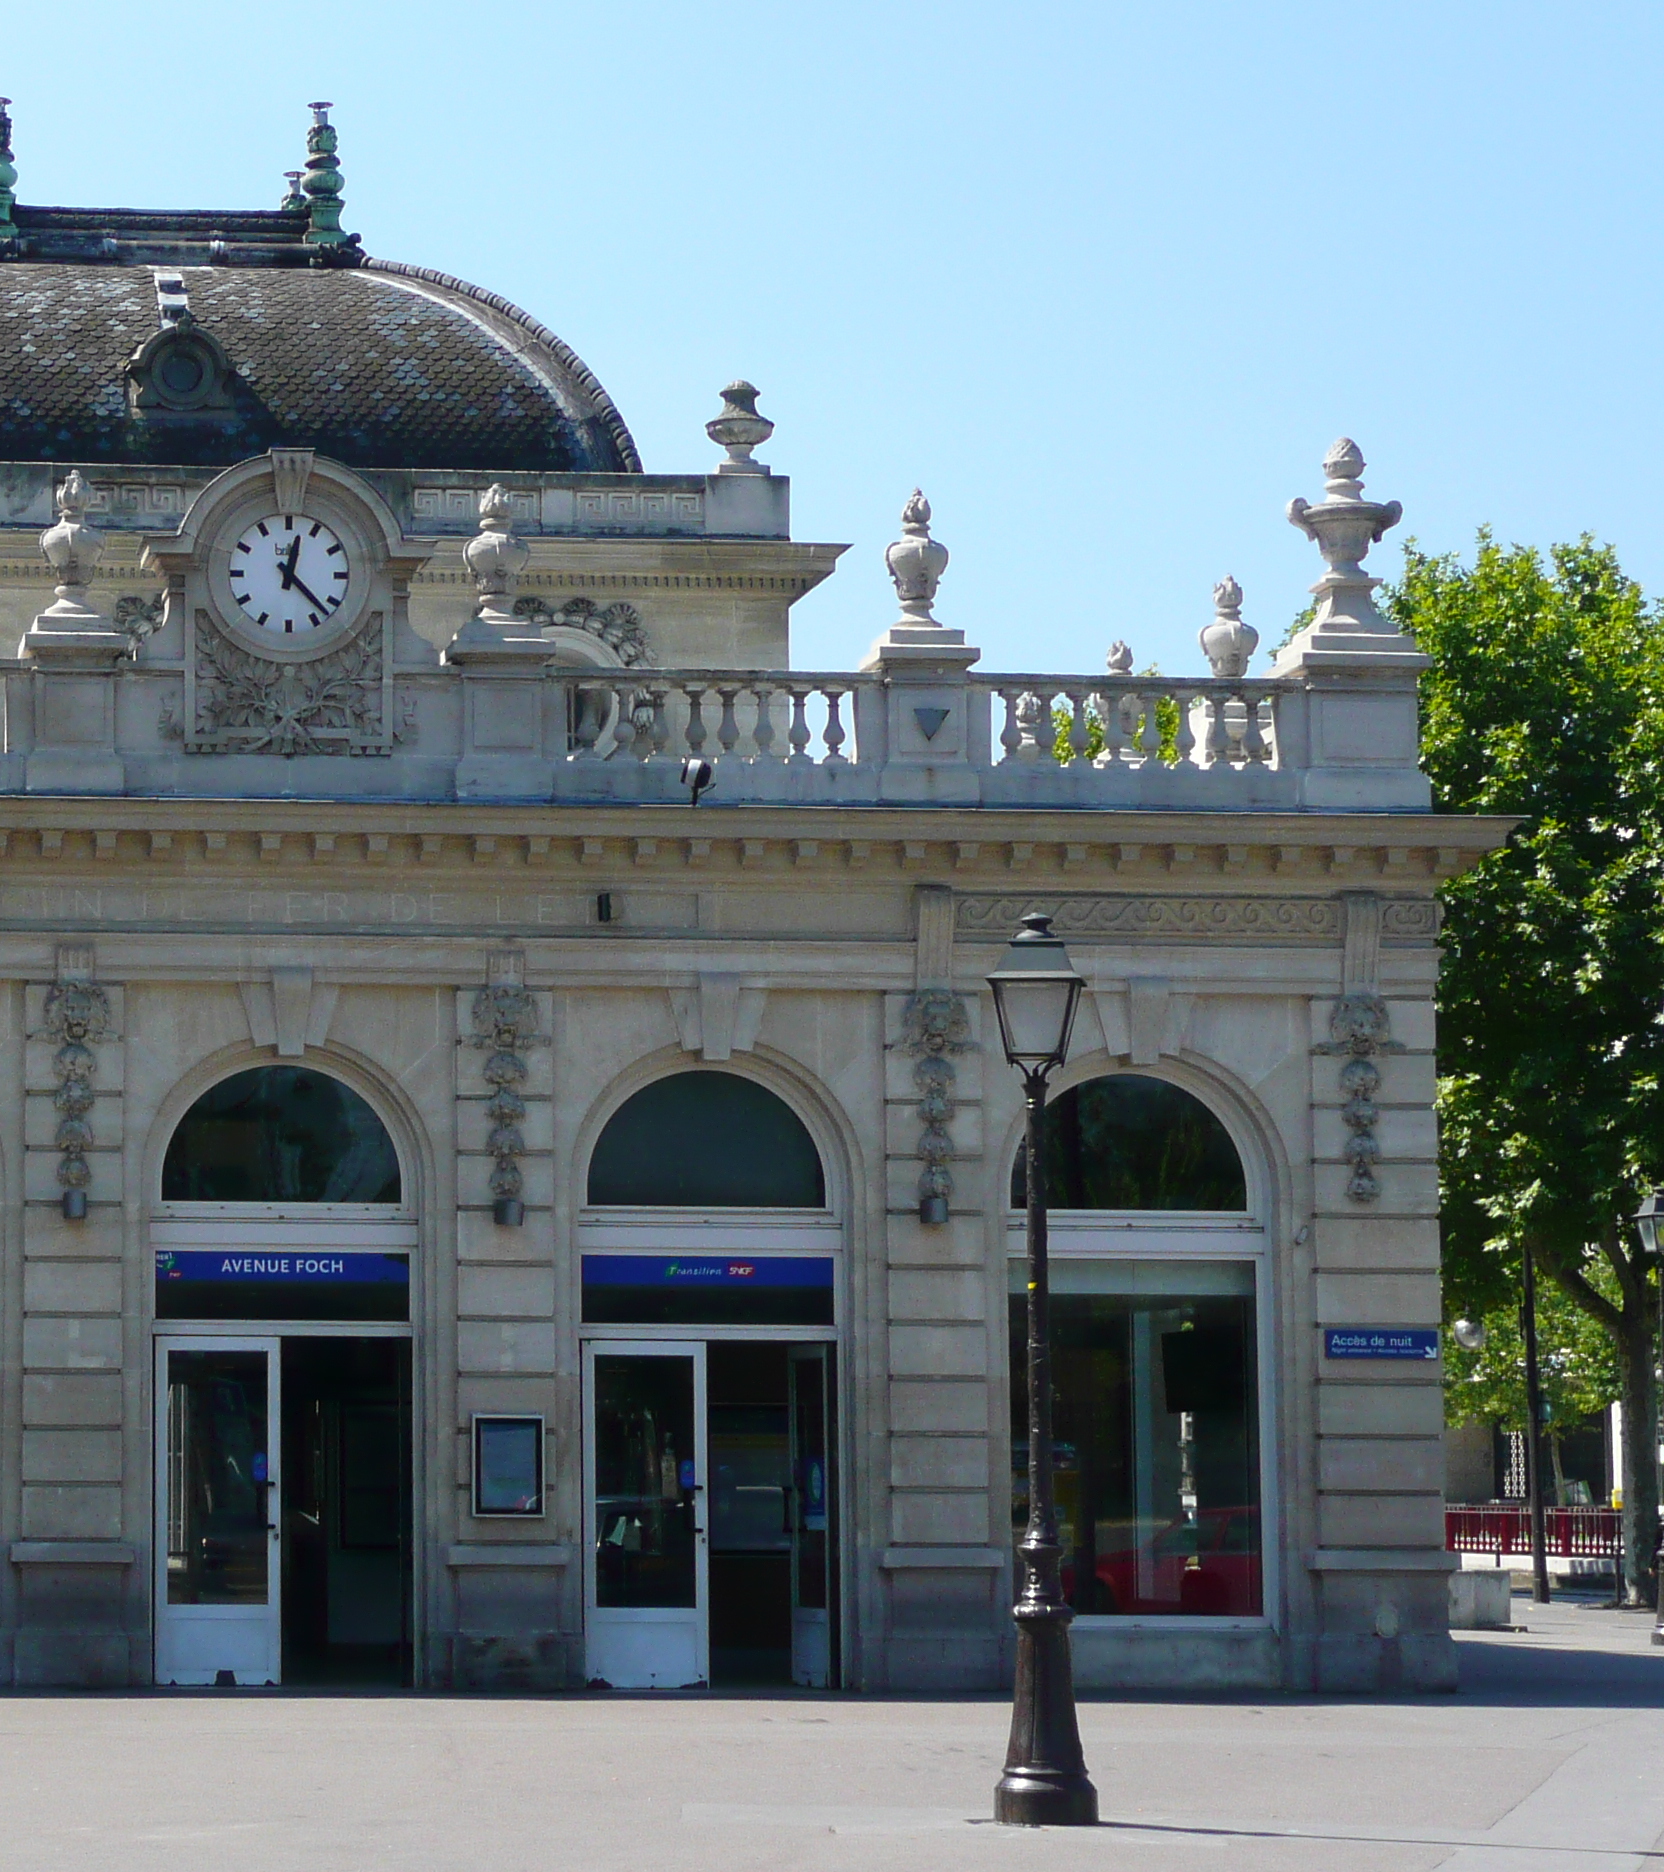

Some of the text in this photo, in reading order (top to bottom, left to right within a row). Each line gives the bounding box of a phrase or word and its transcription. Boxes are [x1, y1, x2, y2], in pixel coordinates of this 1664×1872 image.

[391, 893, 456, 924] DE
[221, 1259, 344, 1273] AVENUE FOCH
[729, 1266, 753, 1276] SNCF
[1331, 1334, 1413, 1347] Accès de nuit
